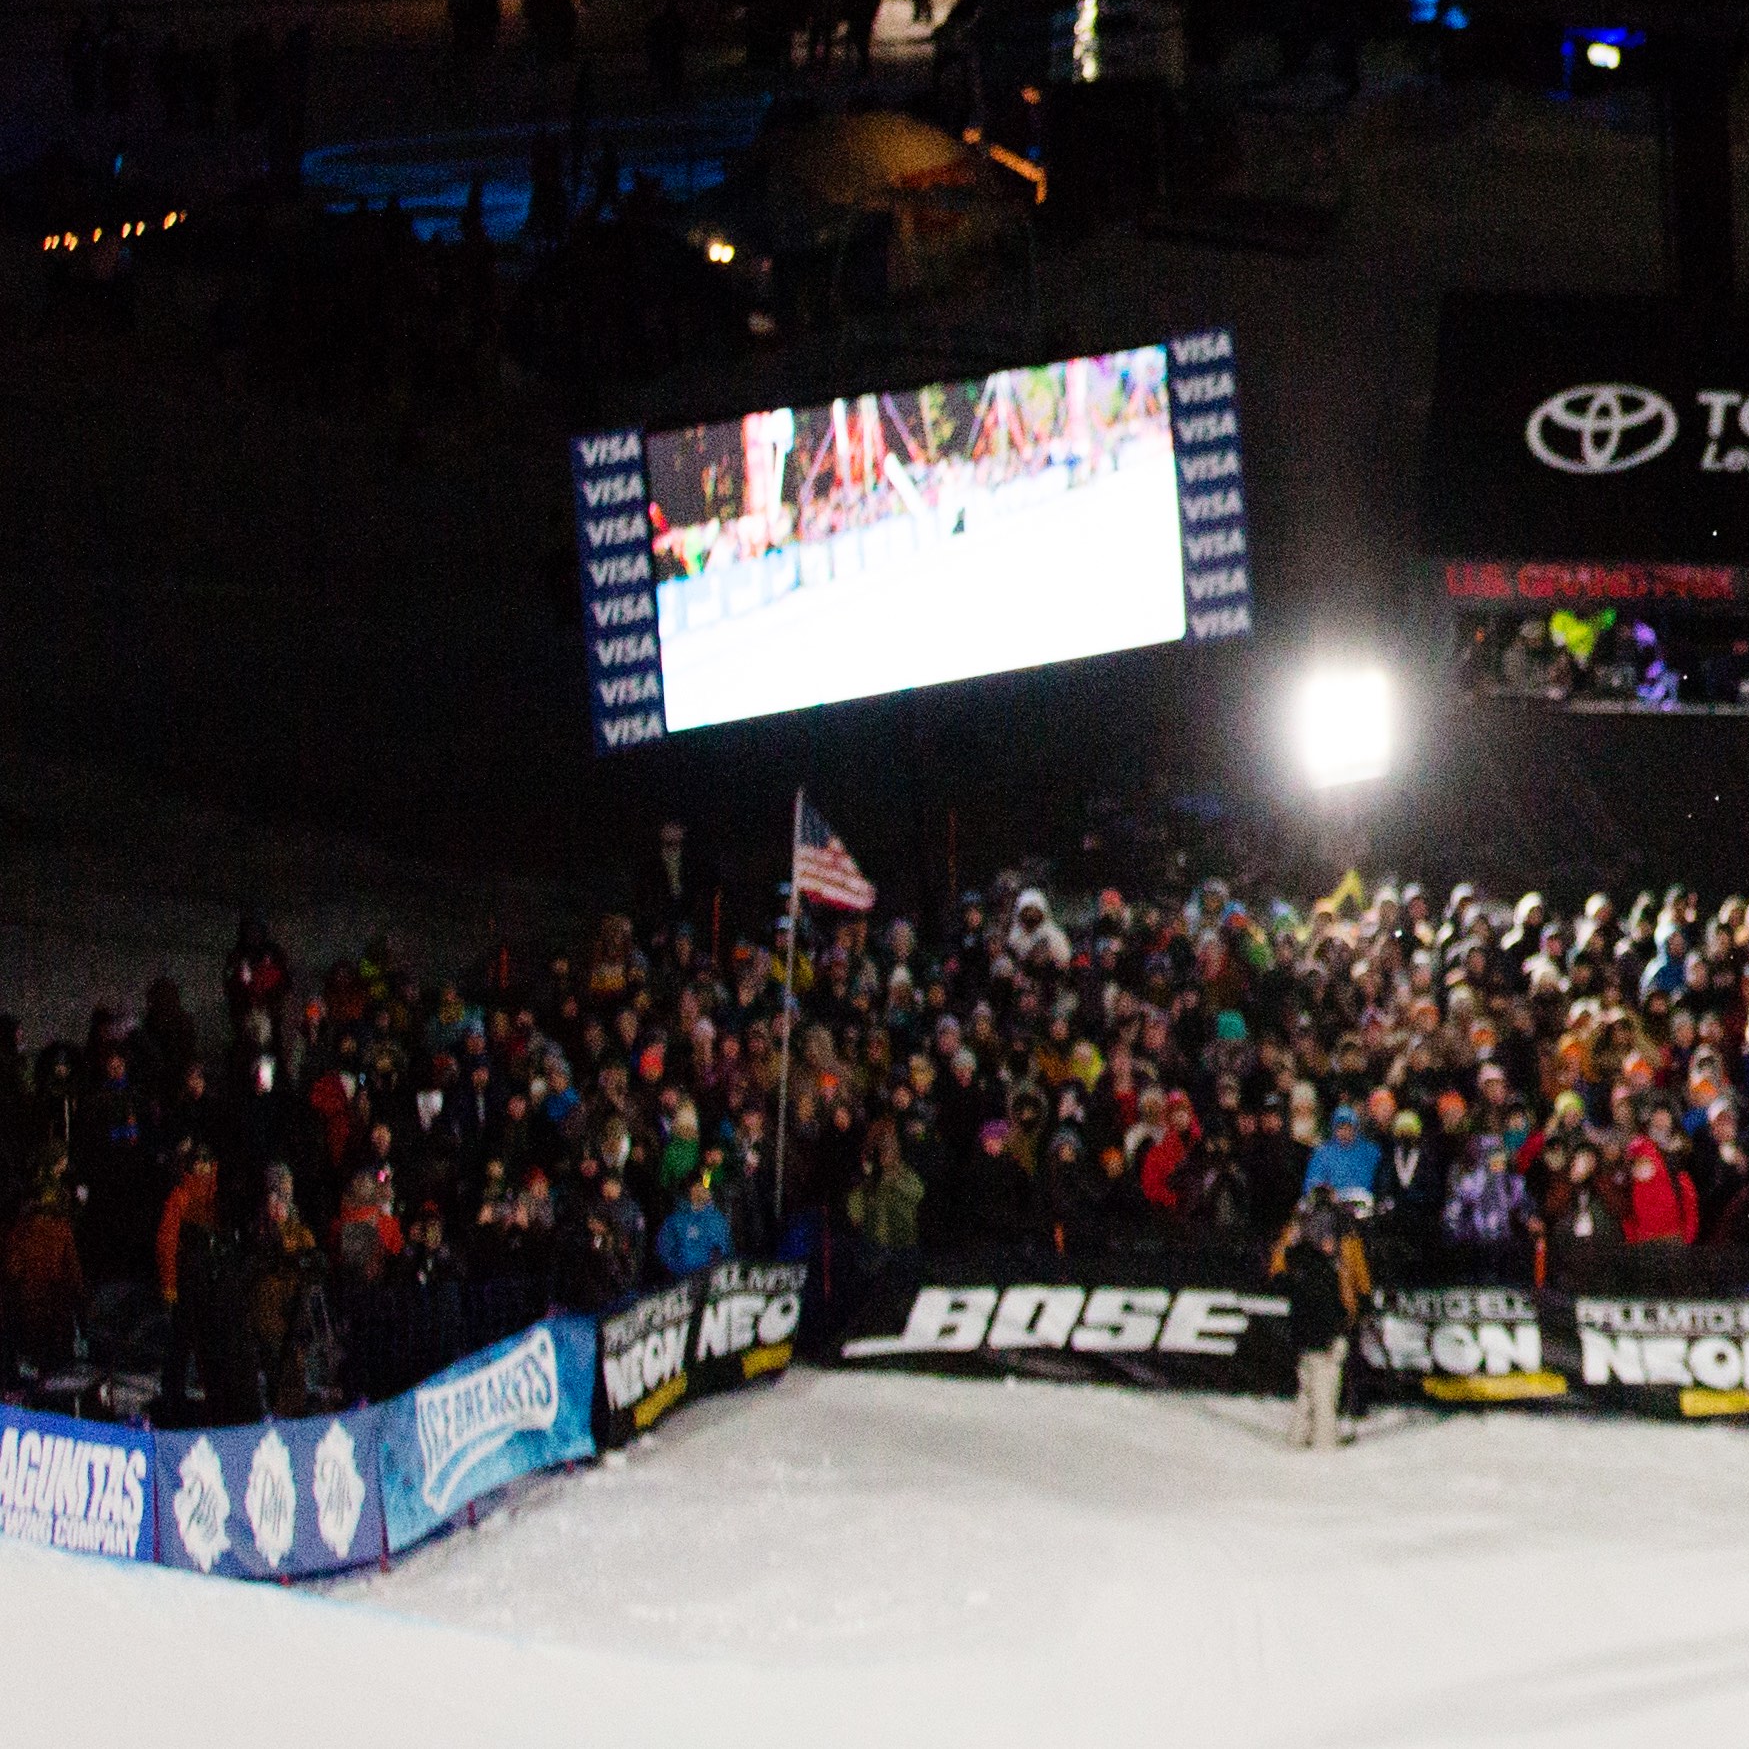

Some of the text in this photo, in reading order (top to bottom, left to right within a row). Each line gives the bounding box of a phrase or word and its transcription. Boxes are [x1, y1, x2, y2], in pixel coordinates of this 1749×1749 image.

[1169, 332, 1232, 366] VISA
[1173, 372, 1235, 404] VISA
[1177, 410, 1237, 443] VISA
[580, 432, 642, 467] VISA
[1180, 449, 1239, 483] VISA
[583, 473, 645, 507] VISA
[1183, 488, 1243, 522] VISA
[585, 512, 648, 547] VISA
[1187, 528, 1246, 560] VISA
[588, 552, 650, 588] VISA
[1189, 567, 1248, 600] VISA
[591, 592, 654, 627] VISA
[1192, 605, 1251, 639] VISA
[595, 633, 657, 667] VISA
[598, 671, 660, 707] VISA
[601, 711, 664, 748] VISA
[842, 1284, 1292, 1356] BOSE
